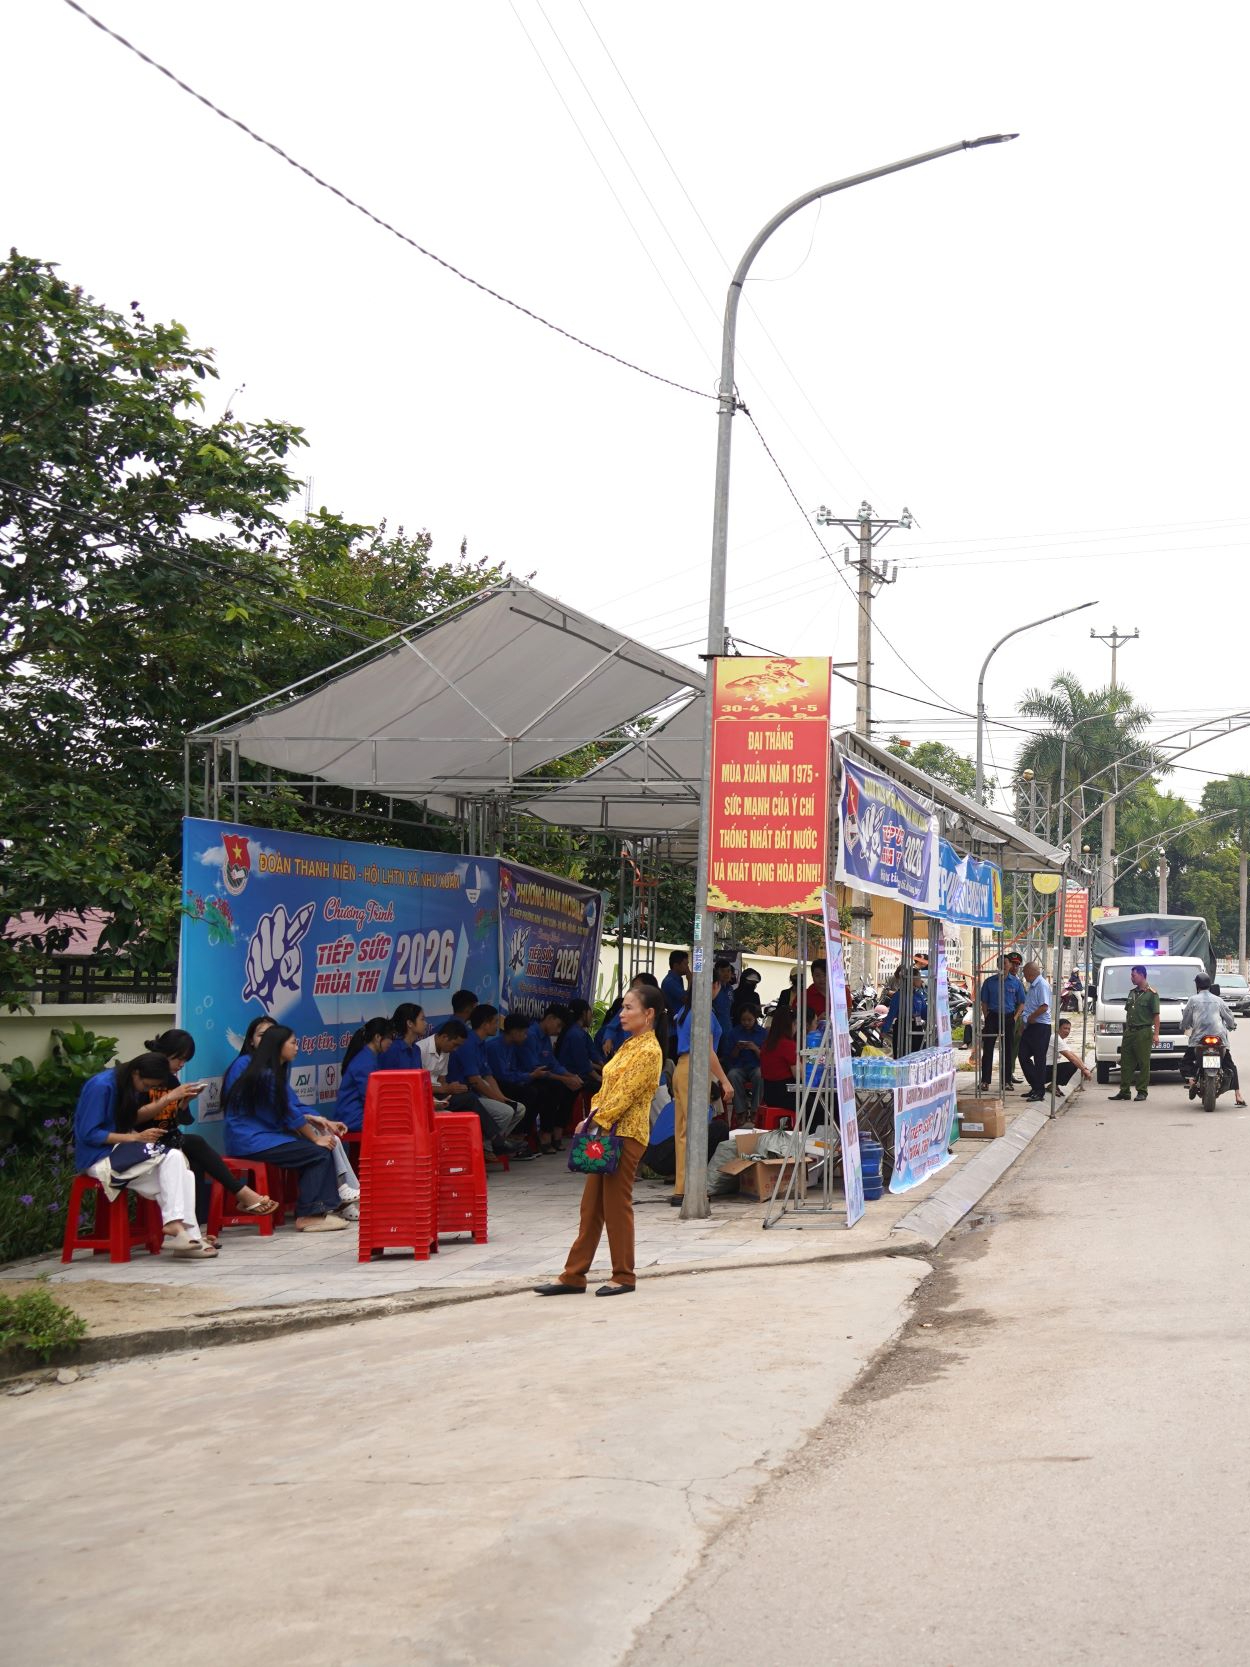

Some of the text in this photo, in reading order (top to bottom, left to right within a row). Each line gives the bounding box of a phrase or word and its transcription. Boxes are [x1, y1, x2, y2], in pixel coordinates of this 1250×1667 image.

[721, 704, 760, 713] 30-4
[790, 704, 818, 713] 1-5
[748, 724, 794, 755] ĐẠI THẮNG
[721, 759, 741, 784] MÙA
[743, 760, 767, 784] XUÂN
[769, 760, 790, 784] NĂM
[792, 765, 813, 784] 1975
[724, 790, 815, 820] SỨC MẠNH CỦA Ý CHÍ
[719, 822, 818, 850] THỐNG NHẤT ĐẤT NƯỚC
[259, 850, 292, 874] ĐOÀN
[294, 858, 330, 879] THANH
[332, 860, 356, 881] NIÊN
[364, 865, 380, 887] HỘI
[381, 868, 405, 885] LHTN
[713, 857, 821, 886] VÀ KHÁT VỌNG HÒA BÌNH!
[323, 896, 395, 930] Chương Trình
[317, 932, 393, 967] TIẾP SỨC
[392, 929, 455, 988] 2026
[554, 948, 580, 981] 2026
[313, 969, 381, 995] MÙA THI
